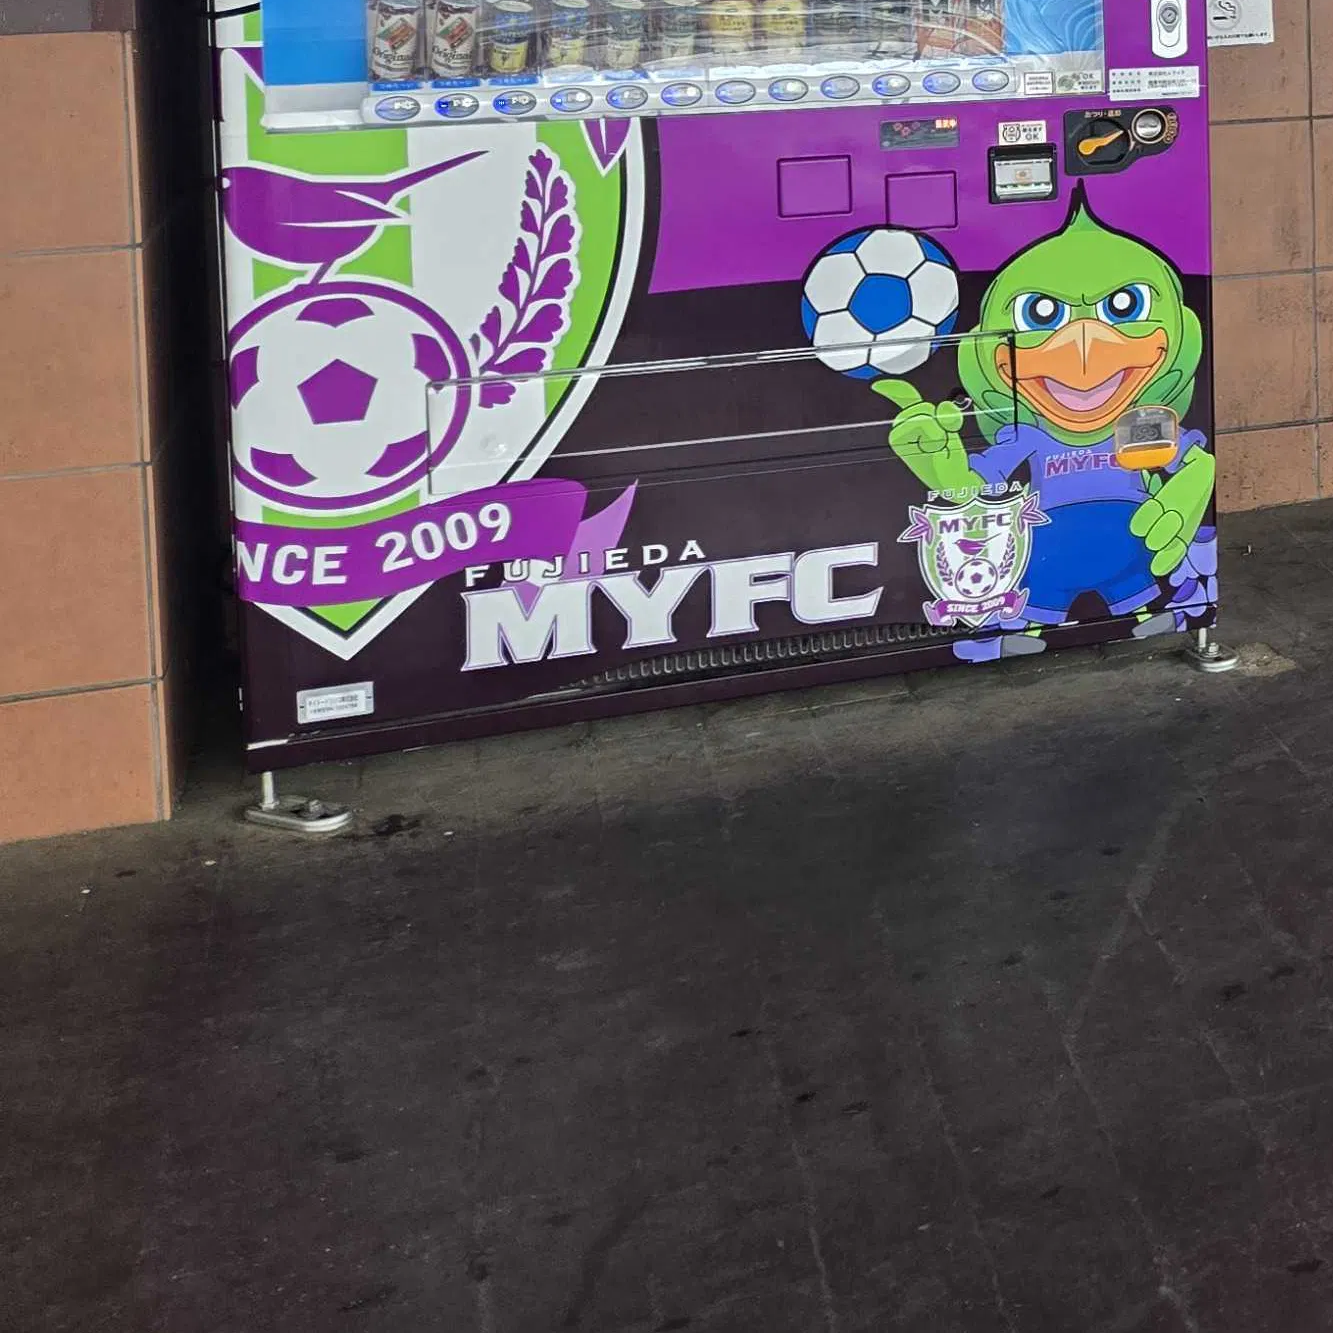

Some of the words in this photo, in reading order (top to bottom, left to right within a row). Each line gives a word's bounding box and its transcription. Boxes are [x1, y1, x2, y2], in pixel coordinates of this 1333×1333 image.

[374, 501, 514, 574] 2009
[938, 512, 1013, 535] MYFC
[465, 539, 706, 588] FUJIEDA
[460, 541, 885, 672] MYFC
[946, 601, 979, 614] SINCE
